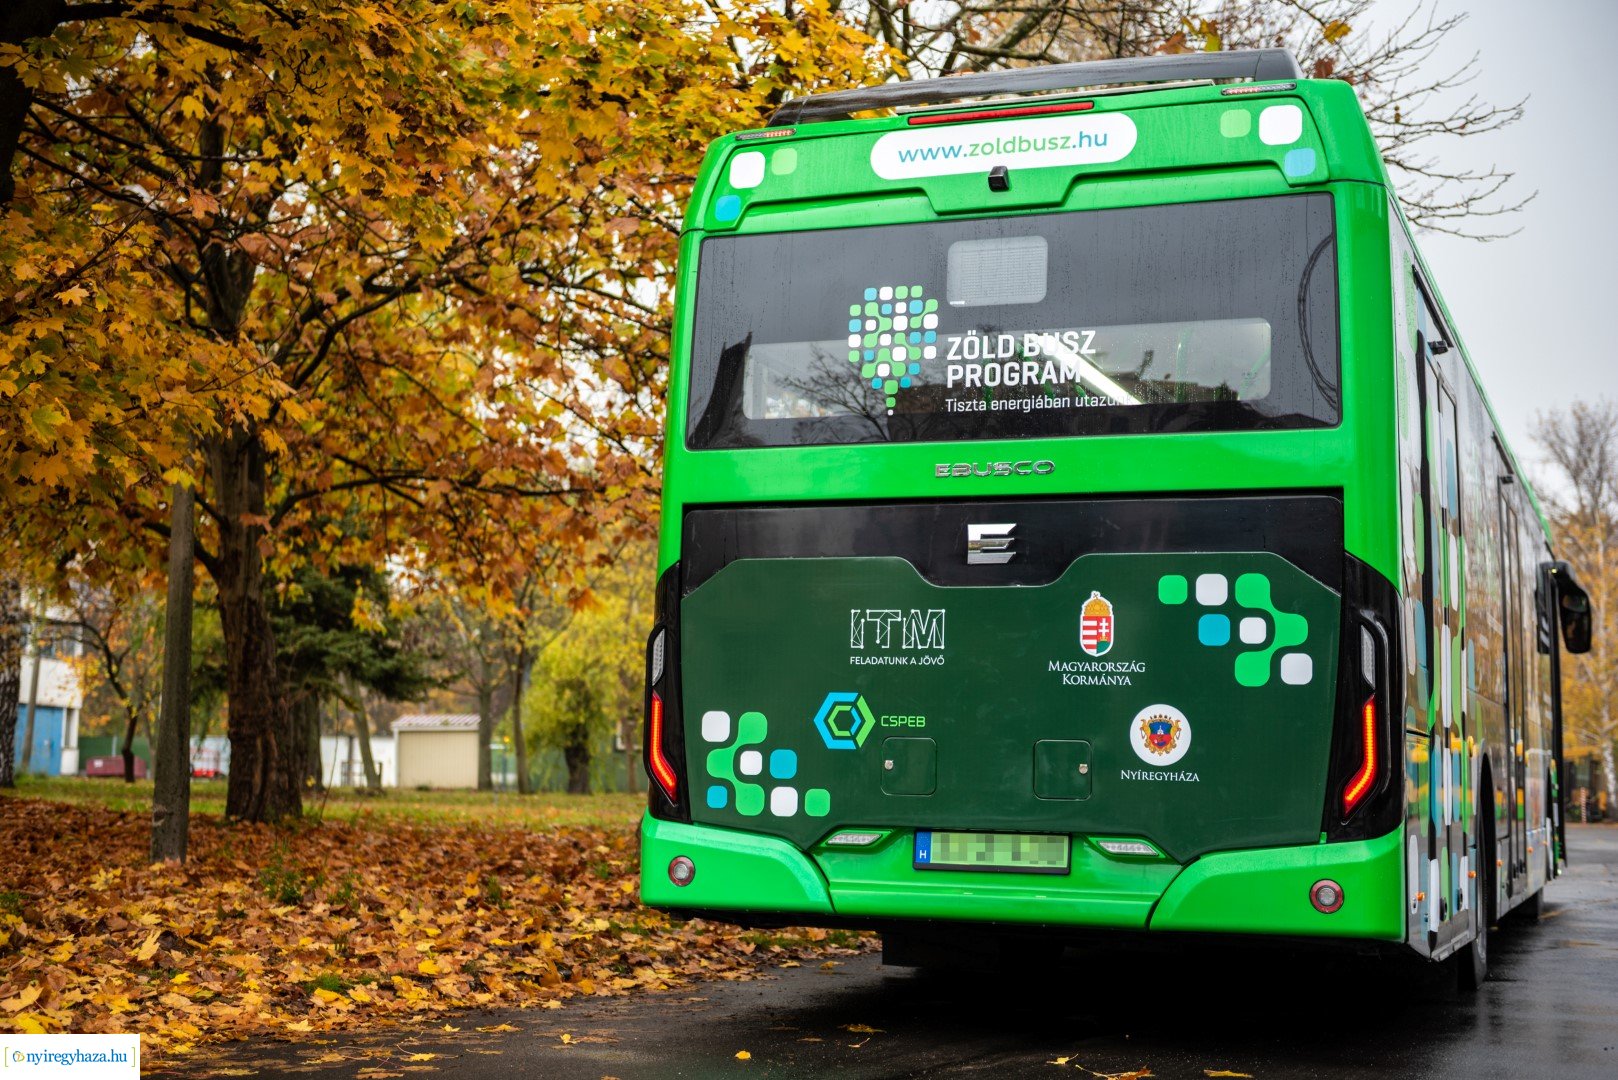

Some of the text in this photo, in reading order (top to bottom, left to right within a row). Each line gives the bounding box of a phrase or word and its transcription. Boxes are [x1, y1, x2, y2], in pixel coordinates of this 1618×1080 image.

[898, 131, 1107, 163] www.zoldbusz.hu
[946, 330, 1096, 361] ZÖLD BUSZ
[946, 360, 1082, 389] PROGRAM
[945, 398, 987, 413] Tiszta
[990, 394, 1071, 413] energiában
[935, 460, 1056, 478] EBUSCO
[850, 608, 946, 650] ITM
[849, 655, 945, 666] FELADATUNK A JÖVŐ
[880, 715, 926, 728] CSPEB
[1120, 769, 1200, 782] NYÍREGYHÁZA
[919, 850, 927, 859] H
